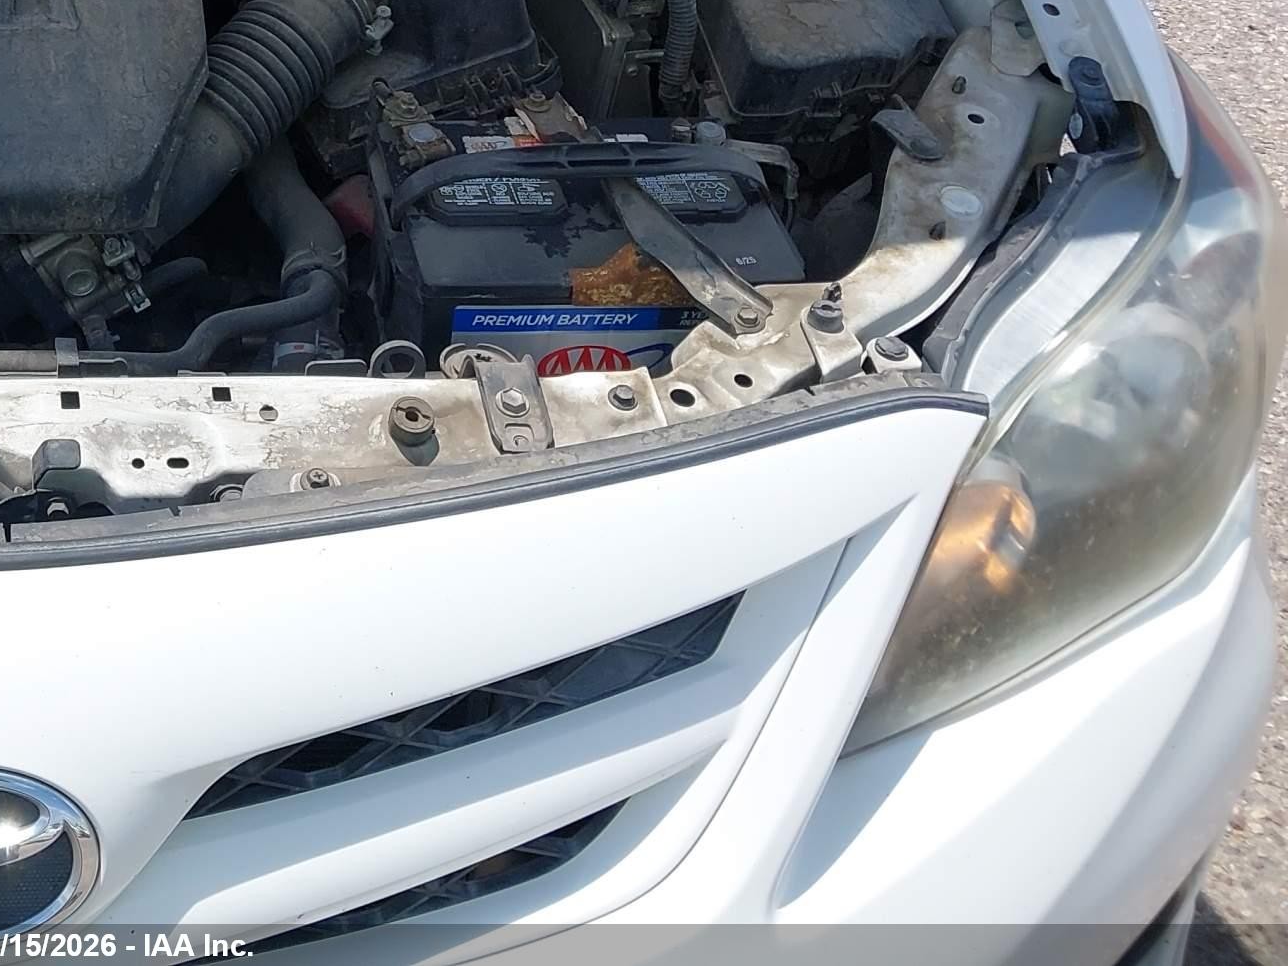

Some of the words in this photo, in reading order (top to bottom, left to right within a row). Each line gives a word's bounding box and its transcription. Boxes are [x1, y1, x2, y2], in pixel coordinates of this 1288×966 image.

[472, 314, 555, 327] PREMIUM
[556, 313, 639, 326] BATTERY
[541, 346, 625, 375] AAA
